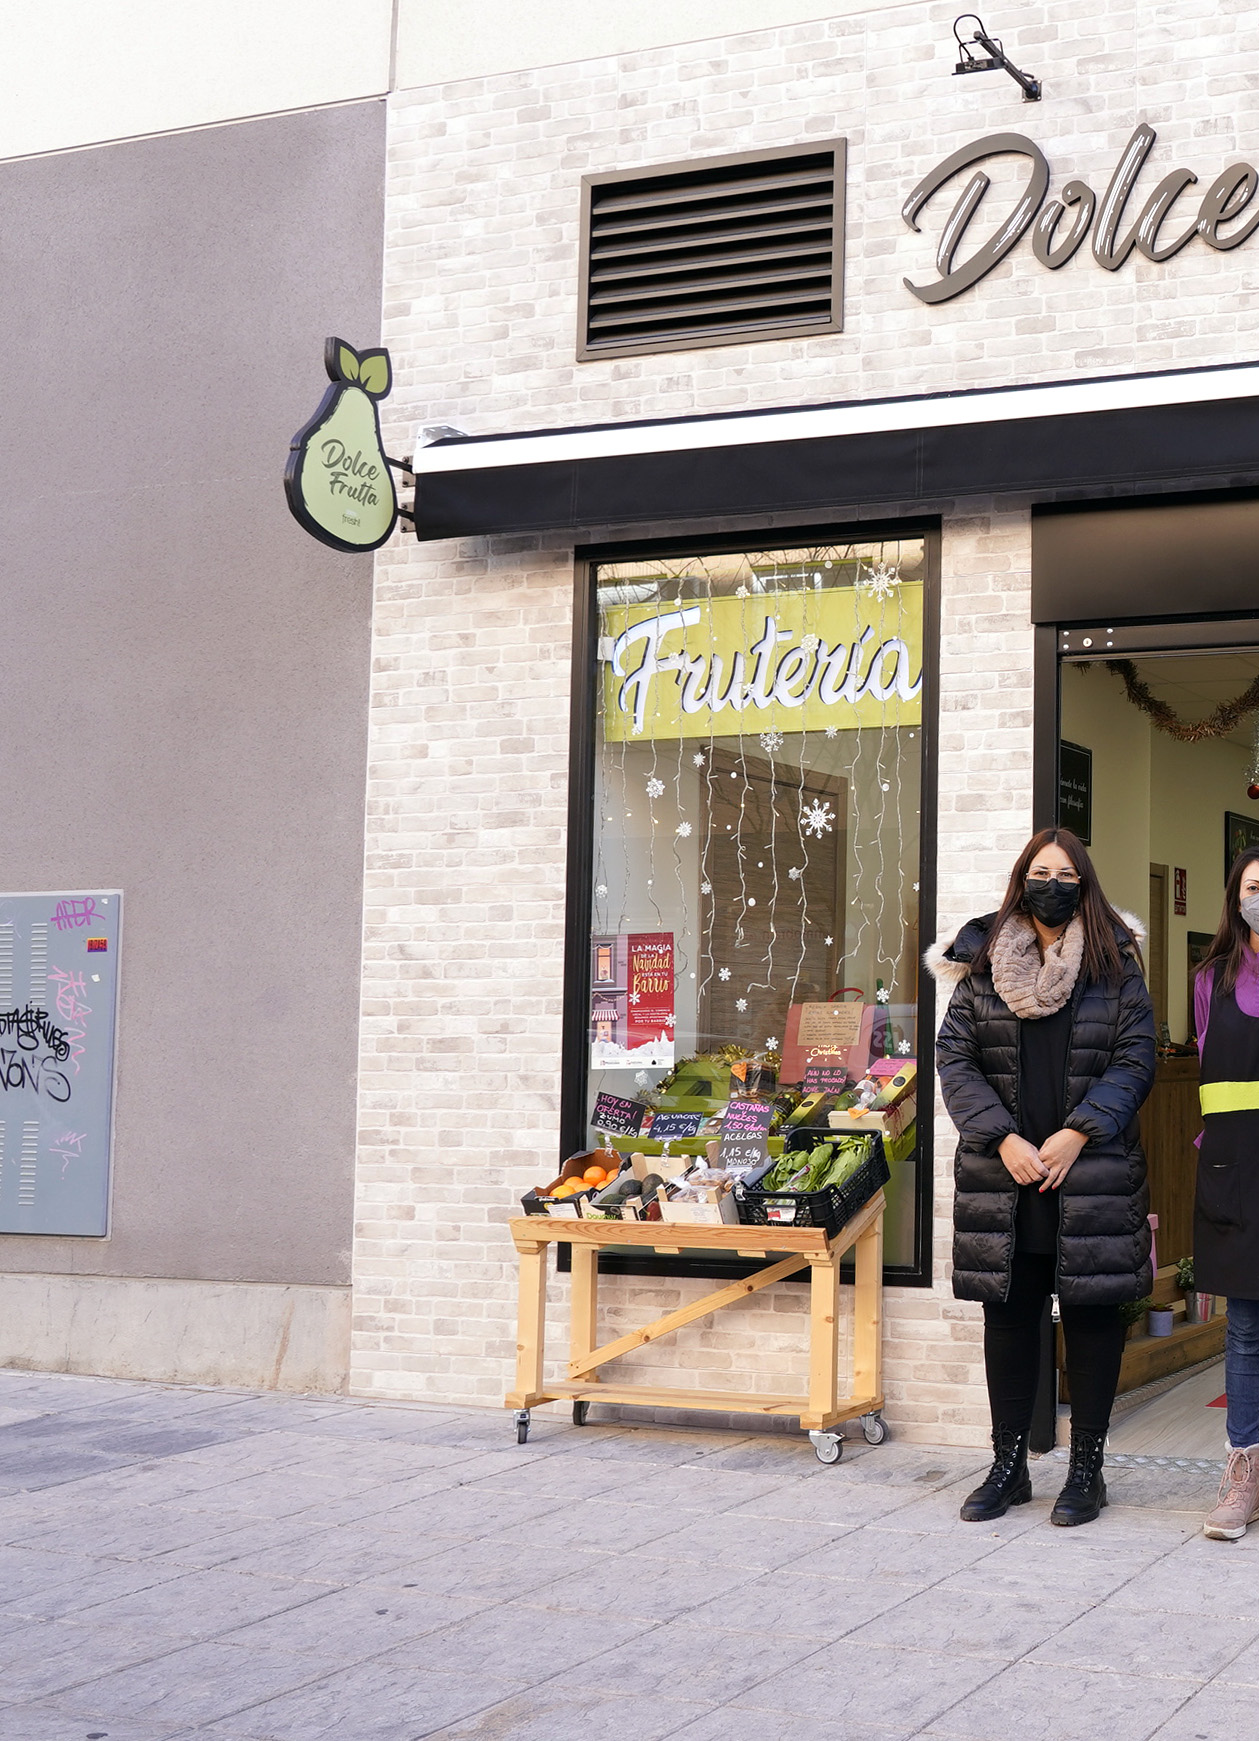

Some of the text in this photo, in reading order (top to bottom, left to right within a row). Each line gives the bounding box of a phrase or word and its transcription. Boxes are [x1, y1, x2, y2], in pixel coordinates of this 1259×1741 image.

[321, 438, 380, 481] Dolce
[329, 471, 380, 507] Frutta
[612, 605, 923, 734] Frutería
[633, 952, 670, 972] Navidad
[619, 1100, 632, 1108] EN
[600, 1112, 625, 1124] ZUMO
[723, 1131, 763, 1141] ACELGAS
